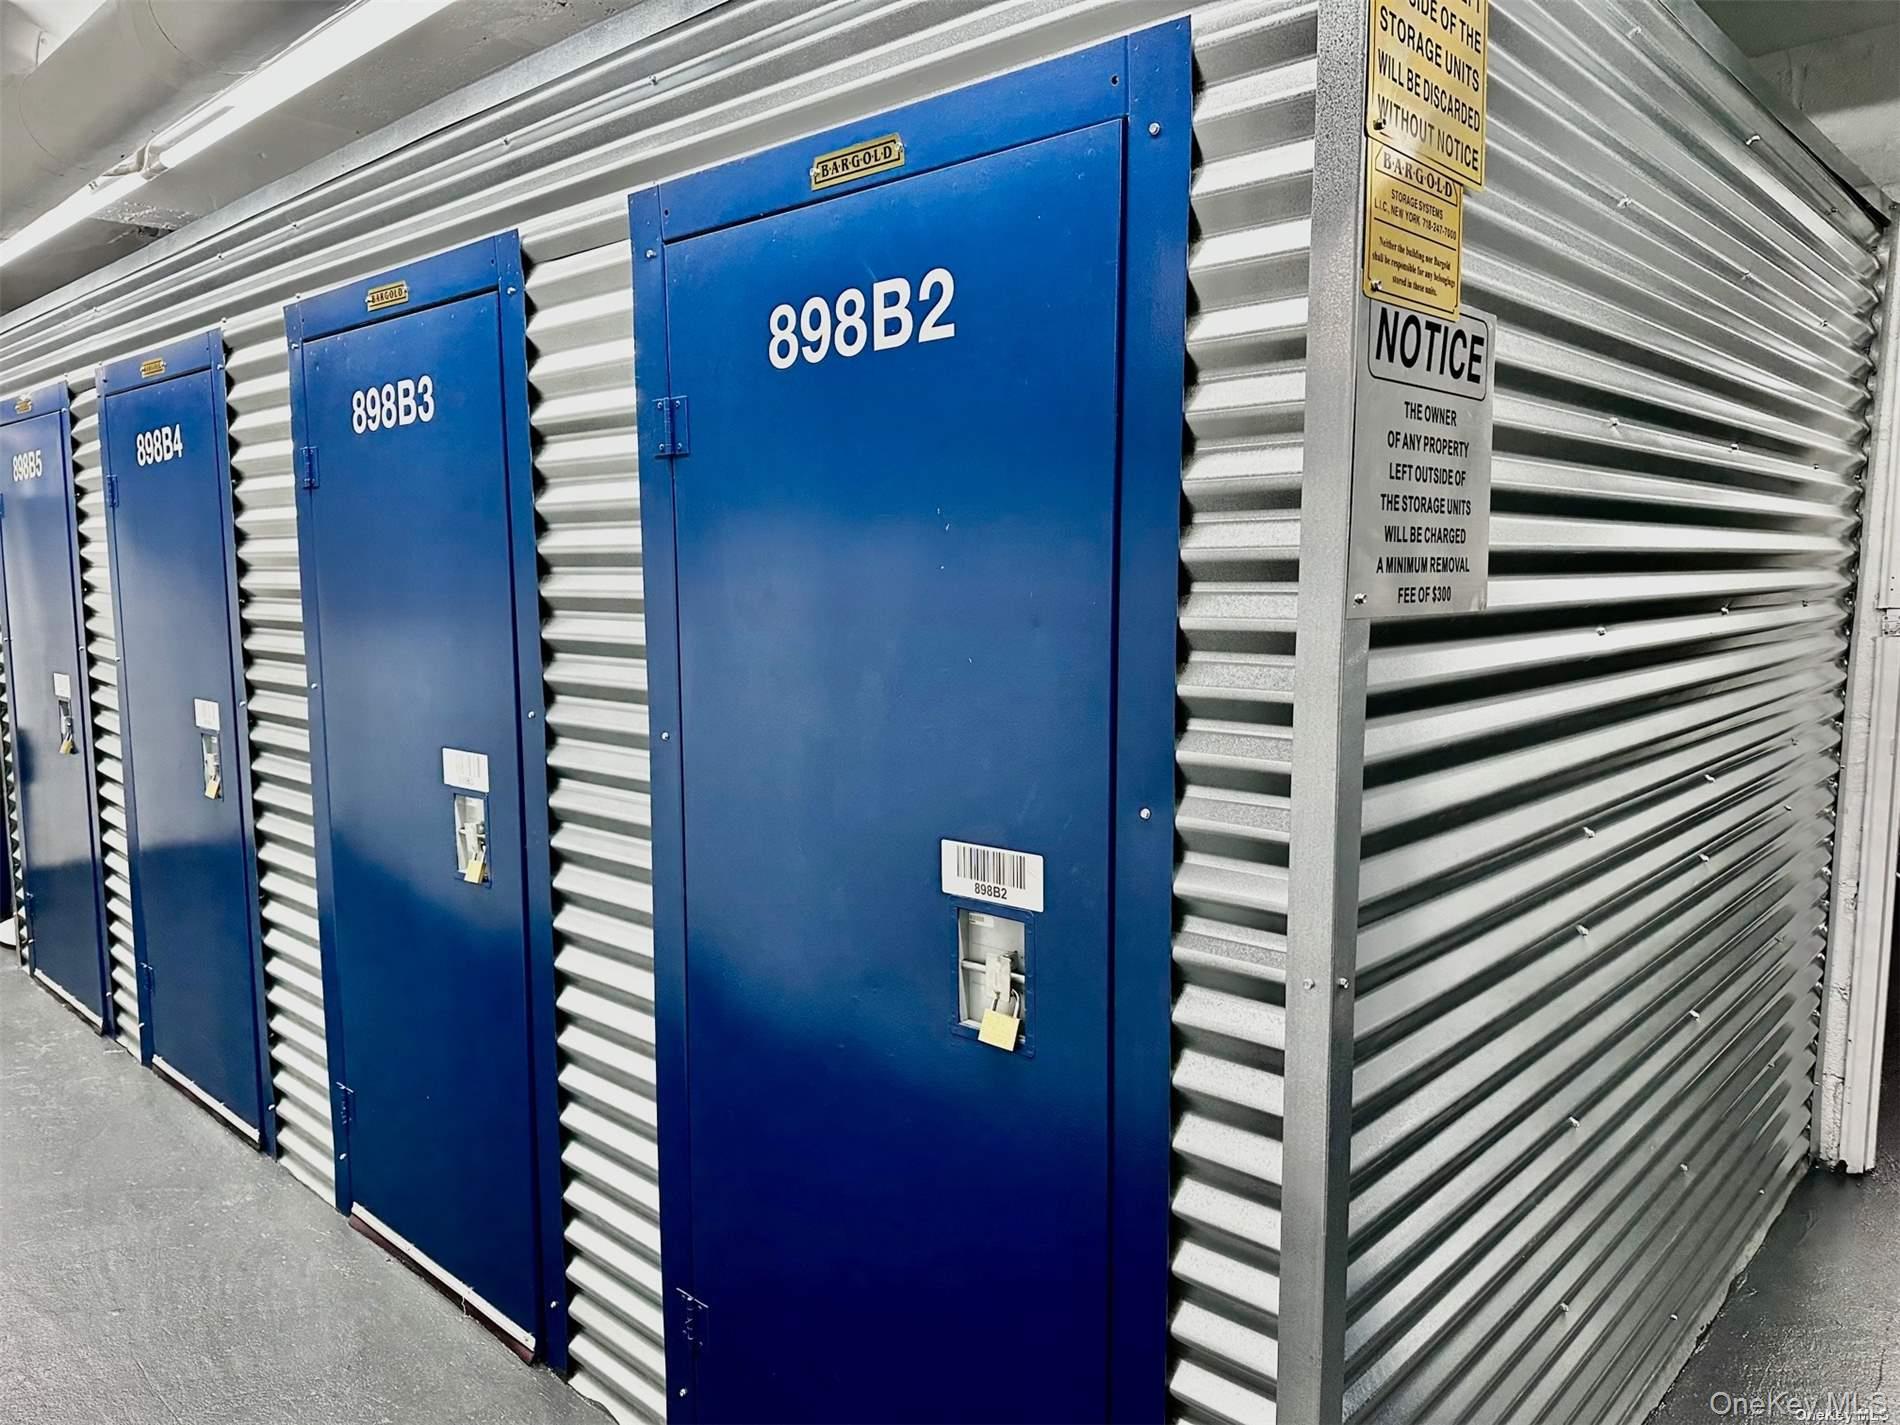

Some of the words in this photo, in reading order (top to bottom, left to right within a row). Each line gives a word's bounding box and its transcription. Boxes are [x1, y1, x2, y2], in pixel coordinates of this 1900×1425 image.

[1441, 6, 1456, 34] OF
[1459, 18, 1481, 54] THE
[1380, 5, 1441, 68] STORAGE
[1445, 50, 1479, 92] UNITS
[1378, 48, 1403, 87] WILL
[1407, 68, 1420, 97] BE
[1423, 78, 1480, 132] DISCARDED
[1378, 93, 1434, 147] WITHOUT
[1437, 129, 1478, 171] NOTICE
[1390, 204, 1404, 219] NEW
[1405, 211, 1420, 225] YORK
[1391, 189, 1418, 211] STORAGE
[1418, 201, 1443, 220] SYSTEMS
[1391, 258, 1416, 274] responsible
[1397, 244, 1405, 254] the
[1406, 247, 1424, 263] building
[768, 267, 956, 370] 898B2
[1376, 307, 1485, 384] NOTICE
[352, 375, 435, 434] 898B3
[1404, 401, 1423, 421] THE
[1424, 405, 1457, 427] OWNER
[136, 423, 183, 467] 898B4
[1387, 430, 1401, 448] OF
[1402, 432, 1422, 452] ANY
[1423, 435, 1470, 458] PROPERTY
[12, 449, 43, 483] 898B5
[1389, 462, 1413, 481] LEFT
[1414, 465, 1454, 486] OUTSIDE
[1454, 470, 1467, 487] OF
[1380, 493, 1400, 512] THE
[1401, 495, 1446, 514] STORAGE
[1447, 498, 1472, 516] UNITS
[1384, 525, 1408, 543] WILL
[1410, 526, 1423, 543] BE
[1424, 527, 1467, 544] CHARGED
[1376, 556, 1384, 574] A
[1385, 557, 1428, 573] MINIMUM
[1429, 557, 1470, 573] REMOVAL
[1397, 586, 1416, 604] FEE
[1418, 586, 1431, 603] OF
[1431, 585, 1452, 603] $300
[974, 882, 1008, 900] 898B2
